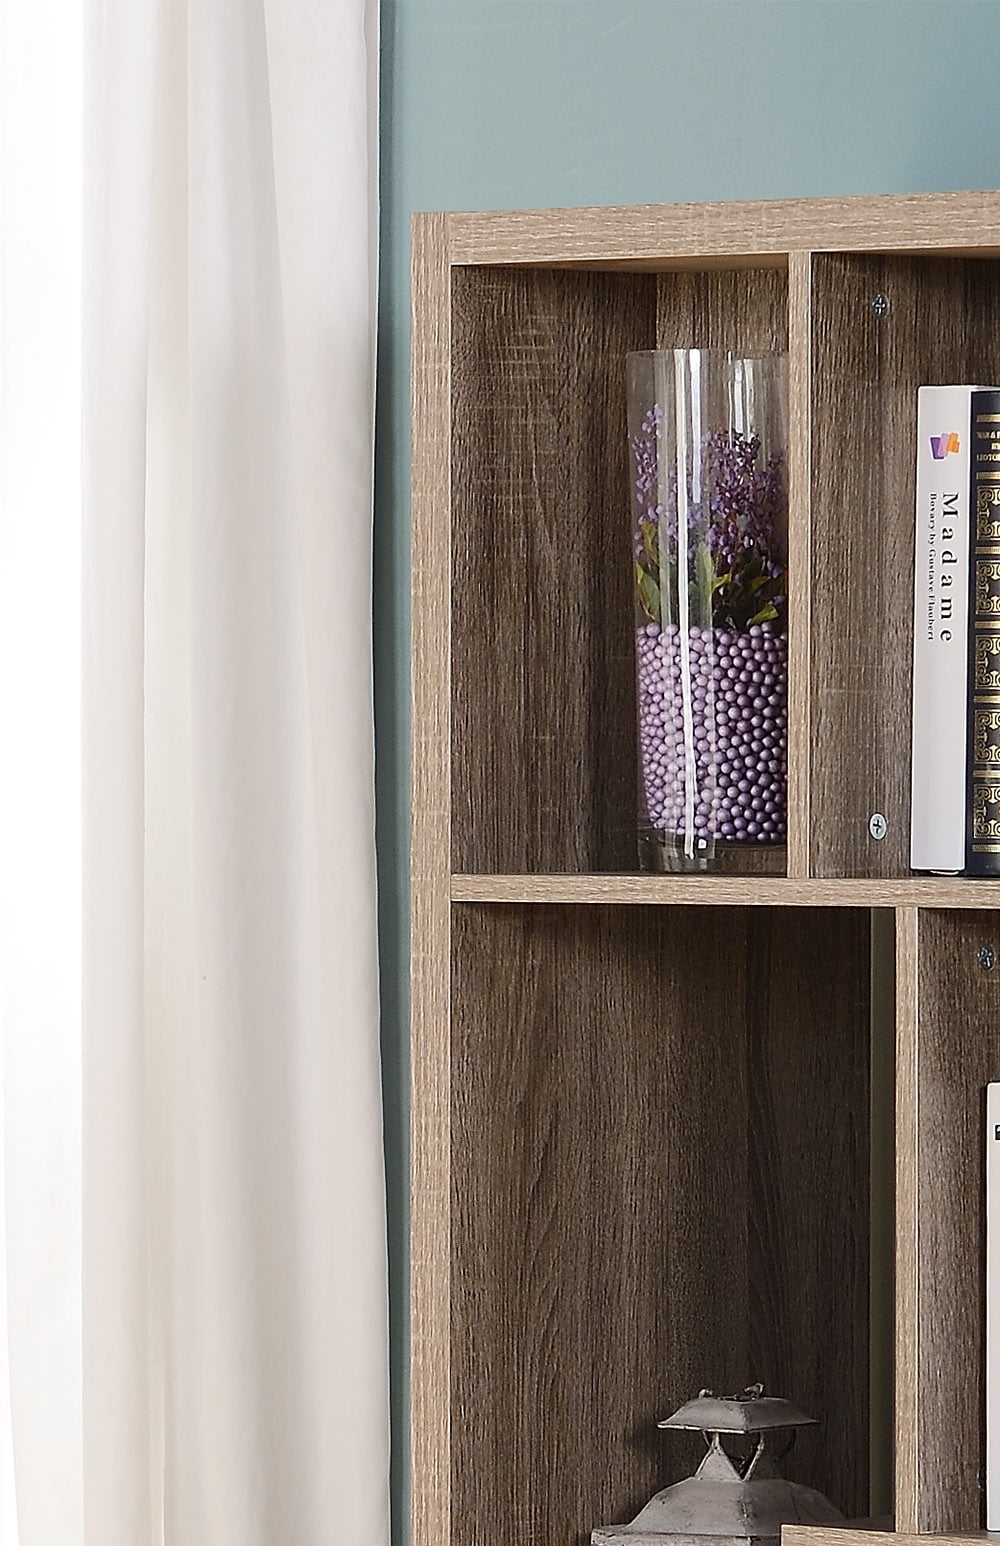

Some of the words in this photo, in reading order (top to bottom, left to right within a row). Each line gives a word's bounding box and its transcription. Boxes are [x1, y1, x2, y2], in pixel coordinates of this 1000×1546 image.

[928, 493, 937, 529] Bovary
[928, 533, 937, 545] by
[928, 549, 937, 592] Gustave
[940, 493, 959, 641] Madame
[927, 595, 936, 640] Flaubert
